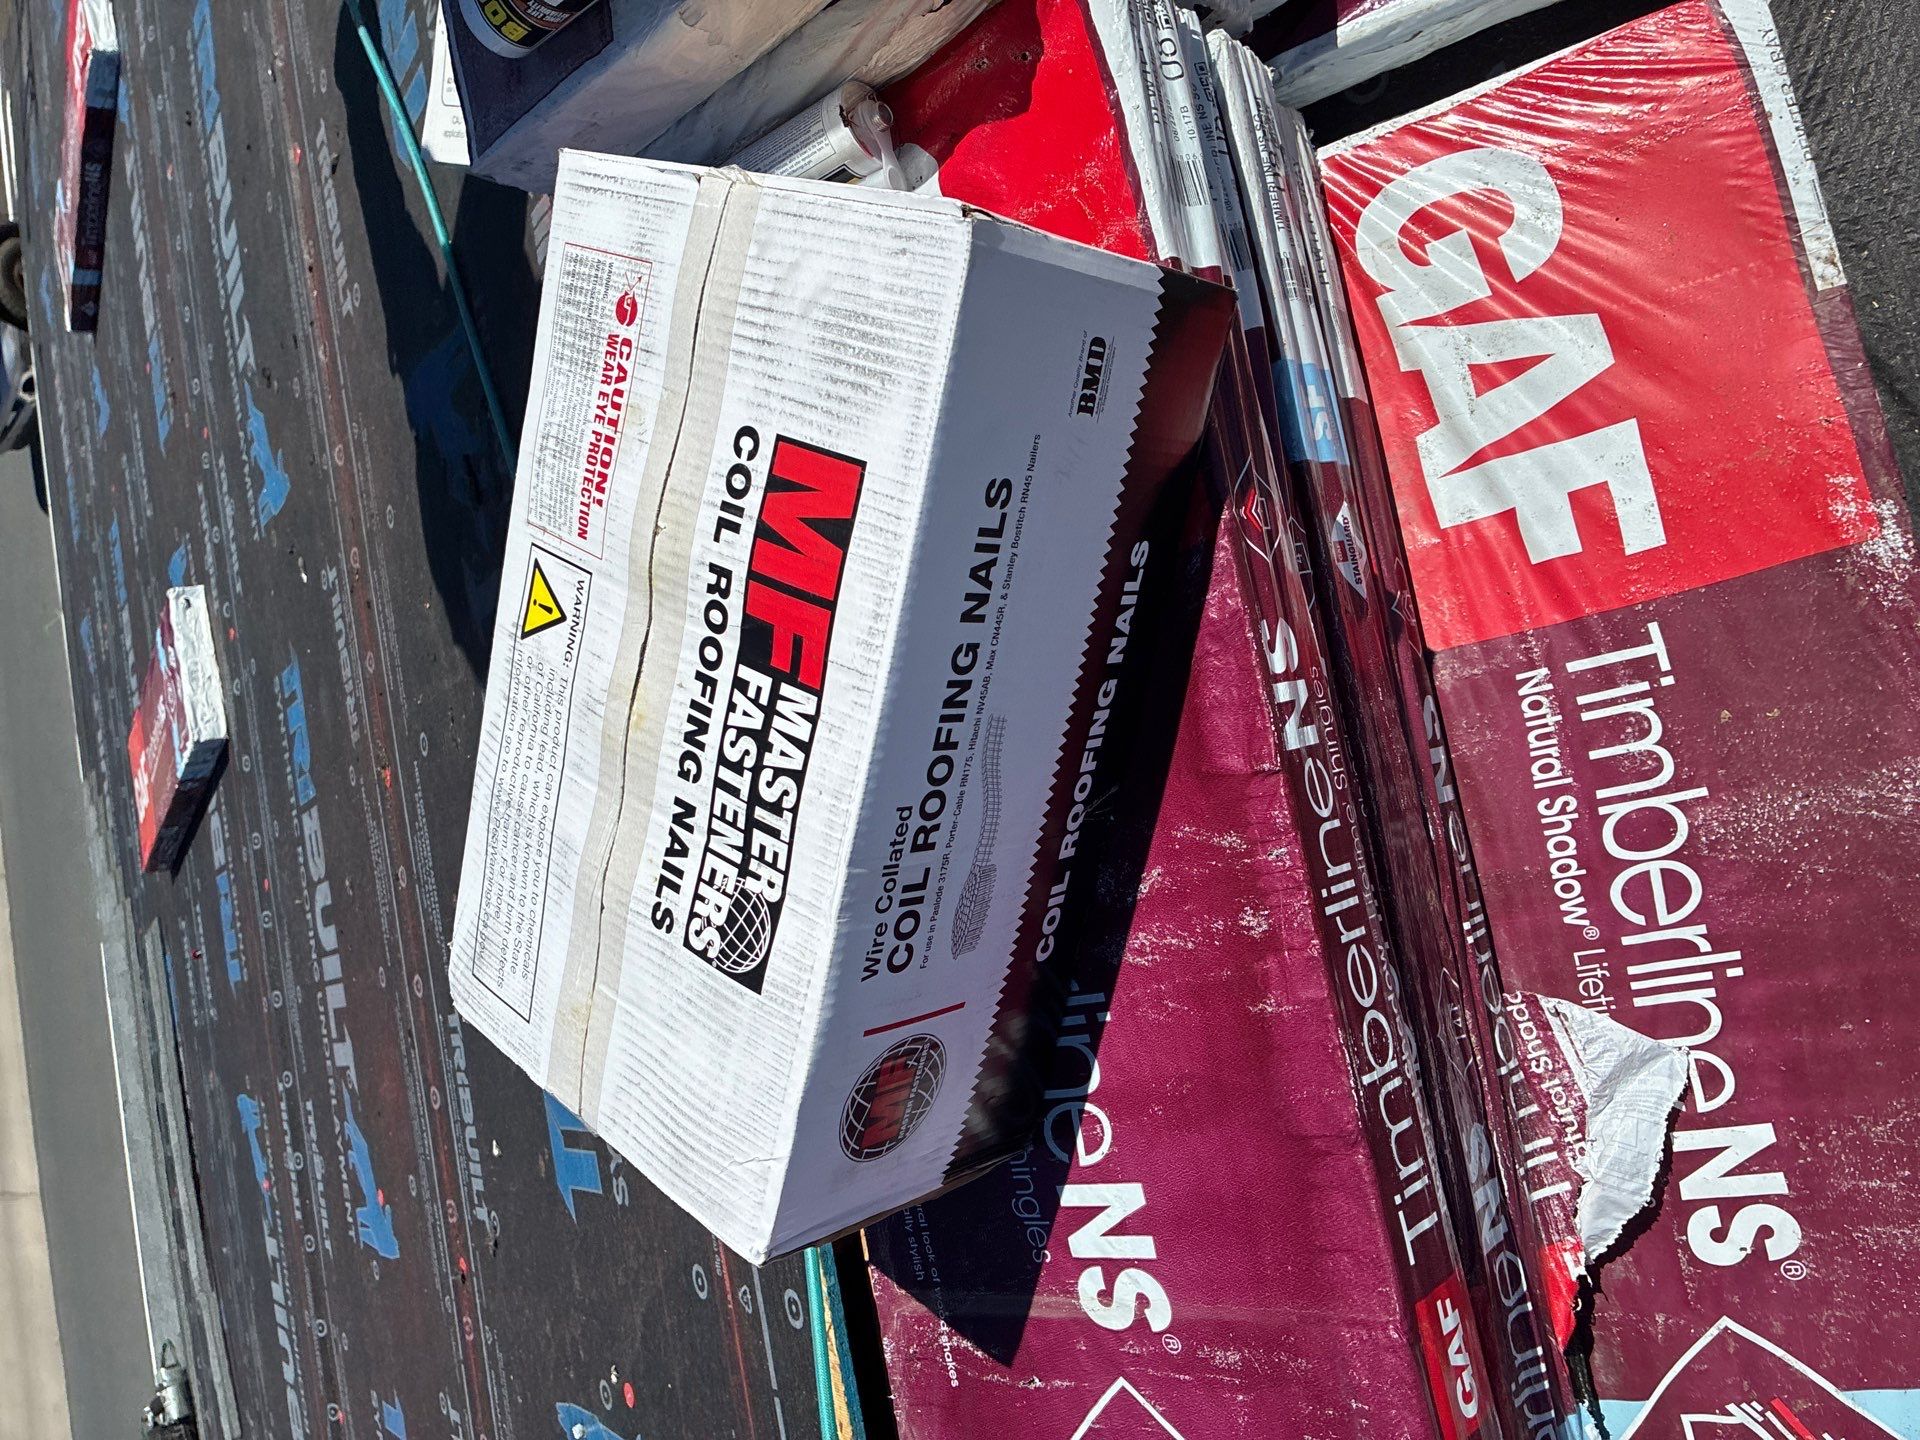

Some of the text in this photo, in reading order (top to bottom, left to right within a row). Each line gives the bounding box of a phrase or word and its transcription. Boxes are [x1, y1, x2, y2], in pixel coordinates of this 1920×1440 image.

[575, 332, 619, 541] WEAR EYE PROTECTION
[591, 335, 632, 507] CAUTION!
[1076, 335, 1107, 417] BMD
[1351, 142, 1667, 565] GAF
[500, 757, 509, 775] to
[501, 733, 510, 756] go
[506, 648, 524, 733] information
[650, 422, 761, 939] COIL ROOFING NAILS
[743, 441, 860, 906] MF MASTER
[885, 472, 1015, 975] COIL ROOFING NAILS
[919, 433, 1040, 969] For use in Paslode 3175R, Porter-Cable RN175, Hitachi NV45AB, Max CN445R, & Stanley Bostitch RN45 Nailers
[1034, 537, 1150, 964] COIL ROOFING NAILS
[1306, 663, 1349, 790] Shingles
[1511, 667, 1571, 792] Natural
[493, 655, 533, 920] or other reproductive harm. For more
[496, 660, 546, 990] of California to cause cancer and birth defects
[510, 665, 557, 976] including lead, which is known to the State
[521, 577, 584, 982] WARNING: This product can expose you to chemicals
[685, 663, 769, 963] FASTENERS
[271, 675, 359, 1244] SYNTHETIC ROOFING UNDERLAYMENT
[860, 803, 913, 983] Wire Collated
[898, 1042, 930, 1139] MASTER FASTENERS
[908, 1236, 925, 1280] stylish
[1007, 1148, 1052, 1264] hingles
[940, 1334, 960, 1387] shakes
[1435, 1294, 1484, 1419] GAF
